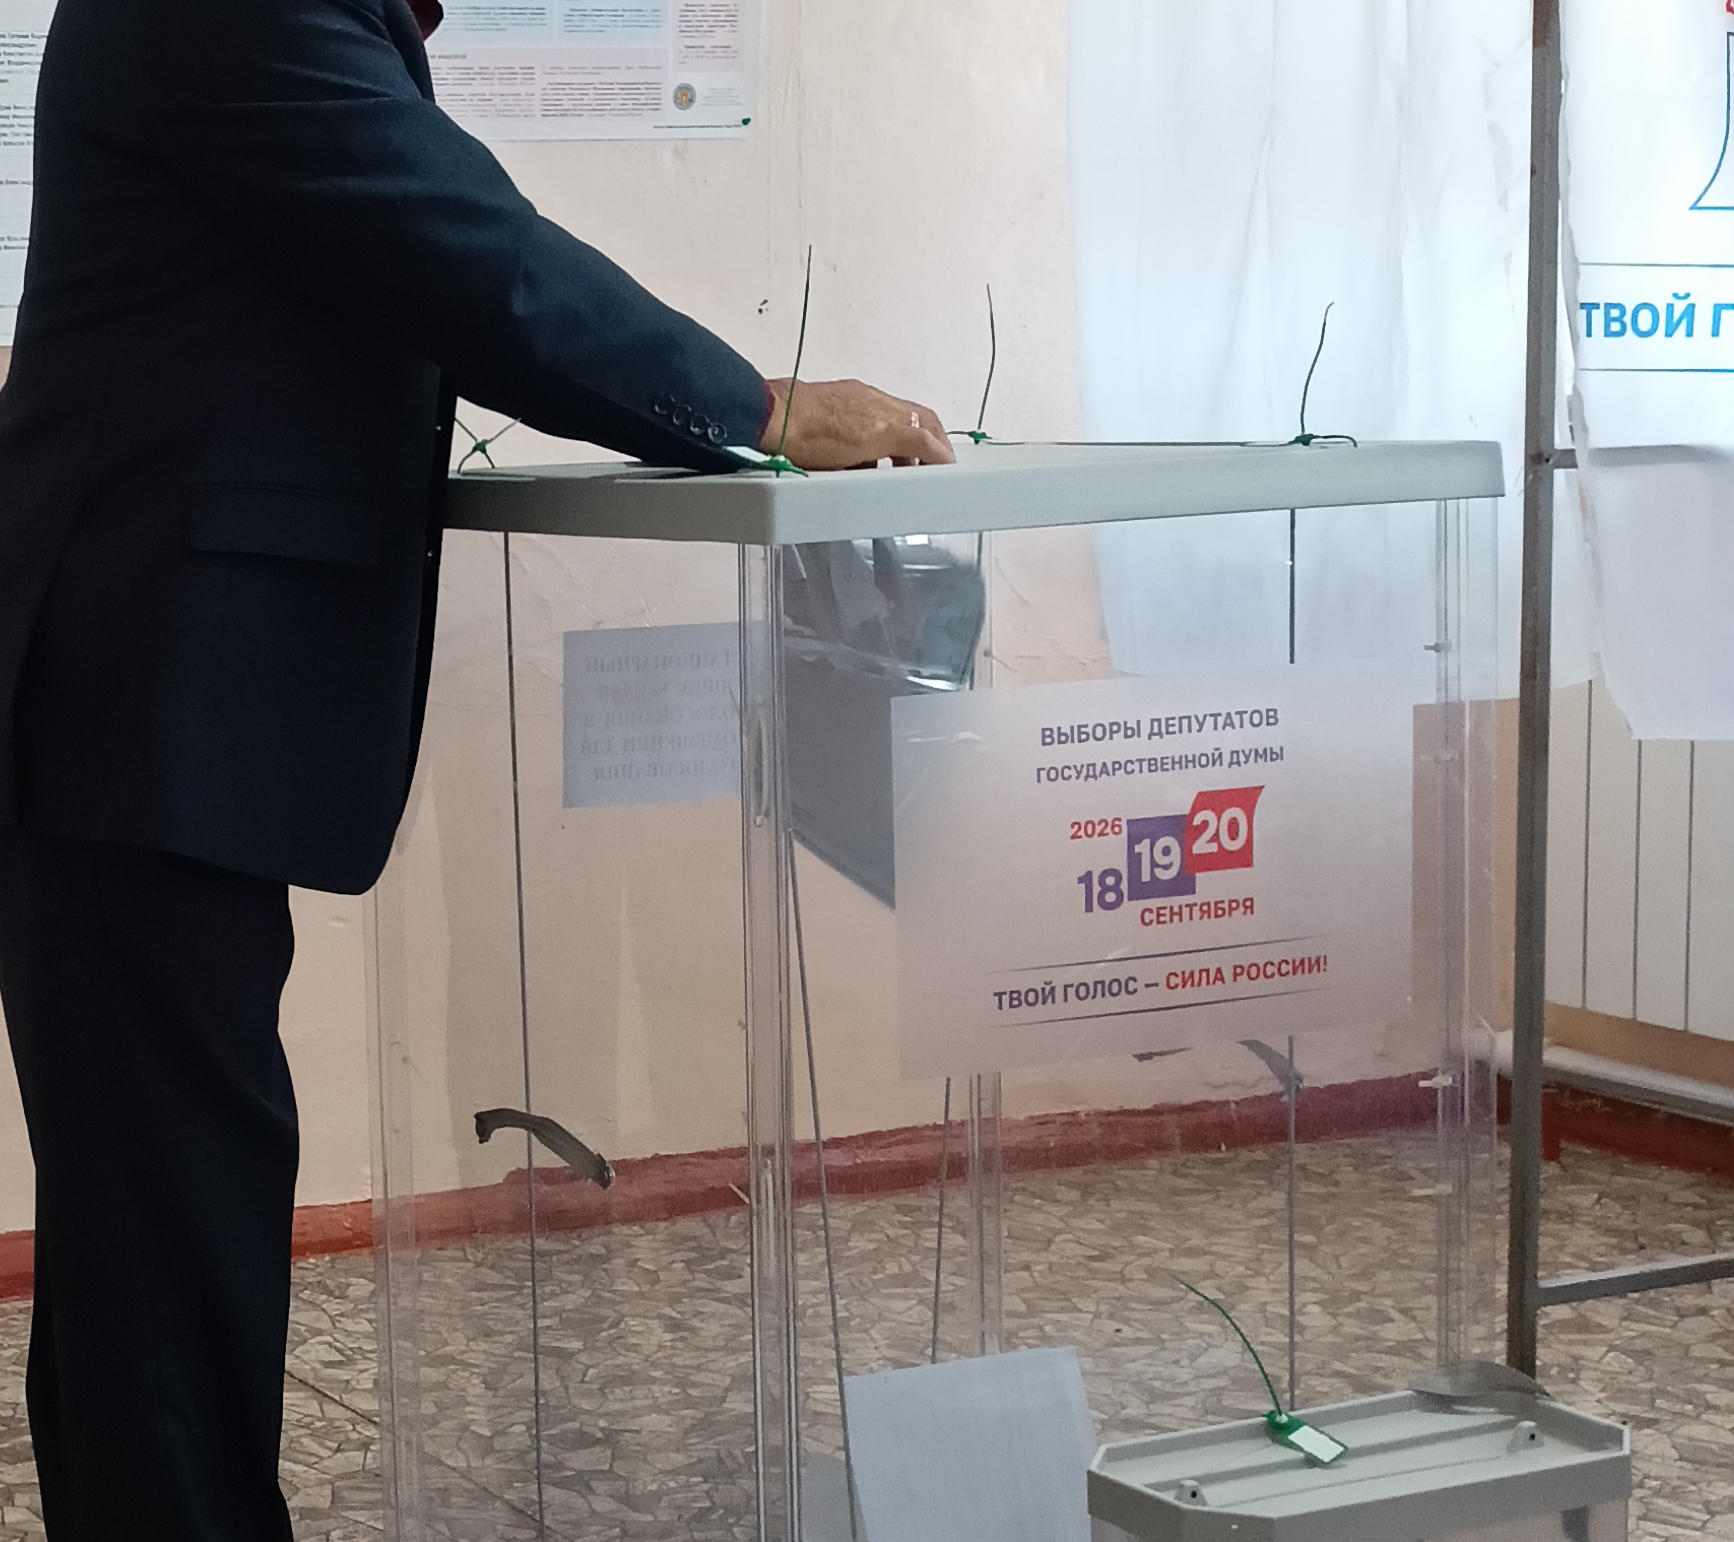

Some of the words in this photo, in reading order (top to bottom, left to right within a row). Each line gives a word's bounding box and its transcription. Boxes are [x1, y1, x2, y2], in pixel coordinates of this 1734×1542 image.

[1579, 292, 1696, 338] ТВОЙ
[1041, 719, 1141, 747] ВЫБОРЫ
[1147, 708, 1279, 740] ДЕПУТАТОВ
[1036, 748, 1224, 784] ГОСУДАРСТВЕННОЙ
[1228, 746, 1285, 768] ДУМЫ
[1070, 817, 1123, 840] 2026
[1077, 868, 1124, 913] 18
[1134, 835, 1182, 883] 19
[1191, 807, 1248, 855] 20
[1139, 897, 1255, 927] СЕНТЯБРЯ
[993, 980, 1057, 1011] ТВОЙ
[1063, 976, 1139, 1003] ГОЛОС
[1165, 966, 1226, 991] СИЛА
[1232, 955, 1328, 983] РОССИИ!
